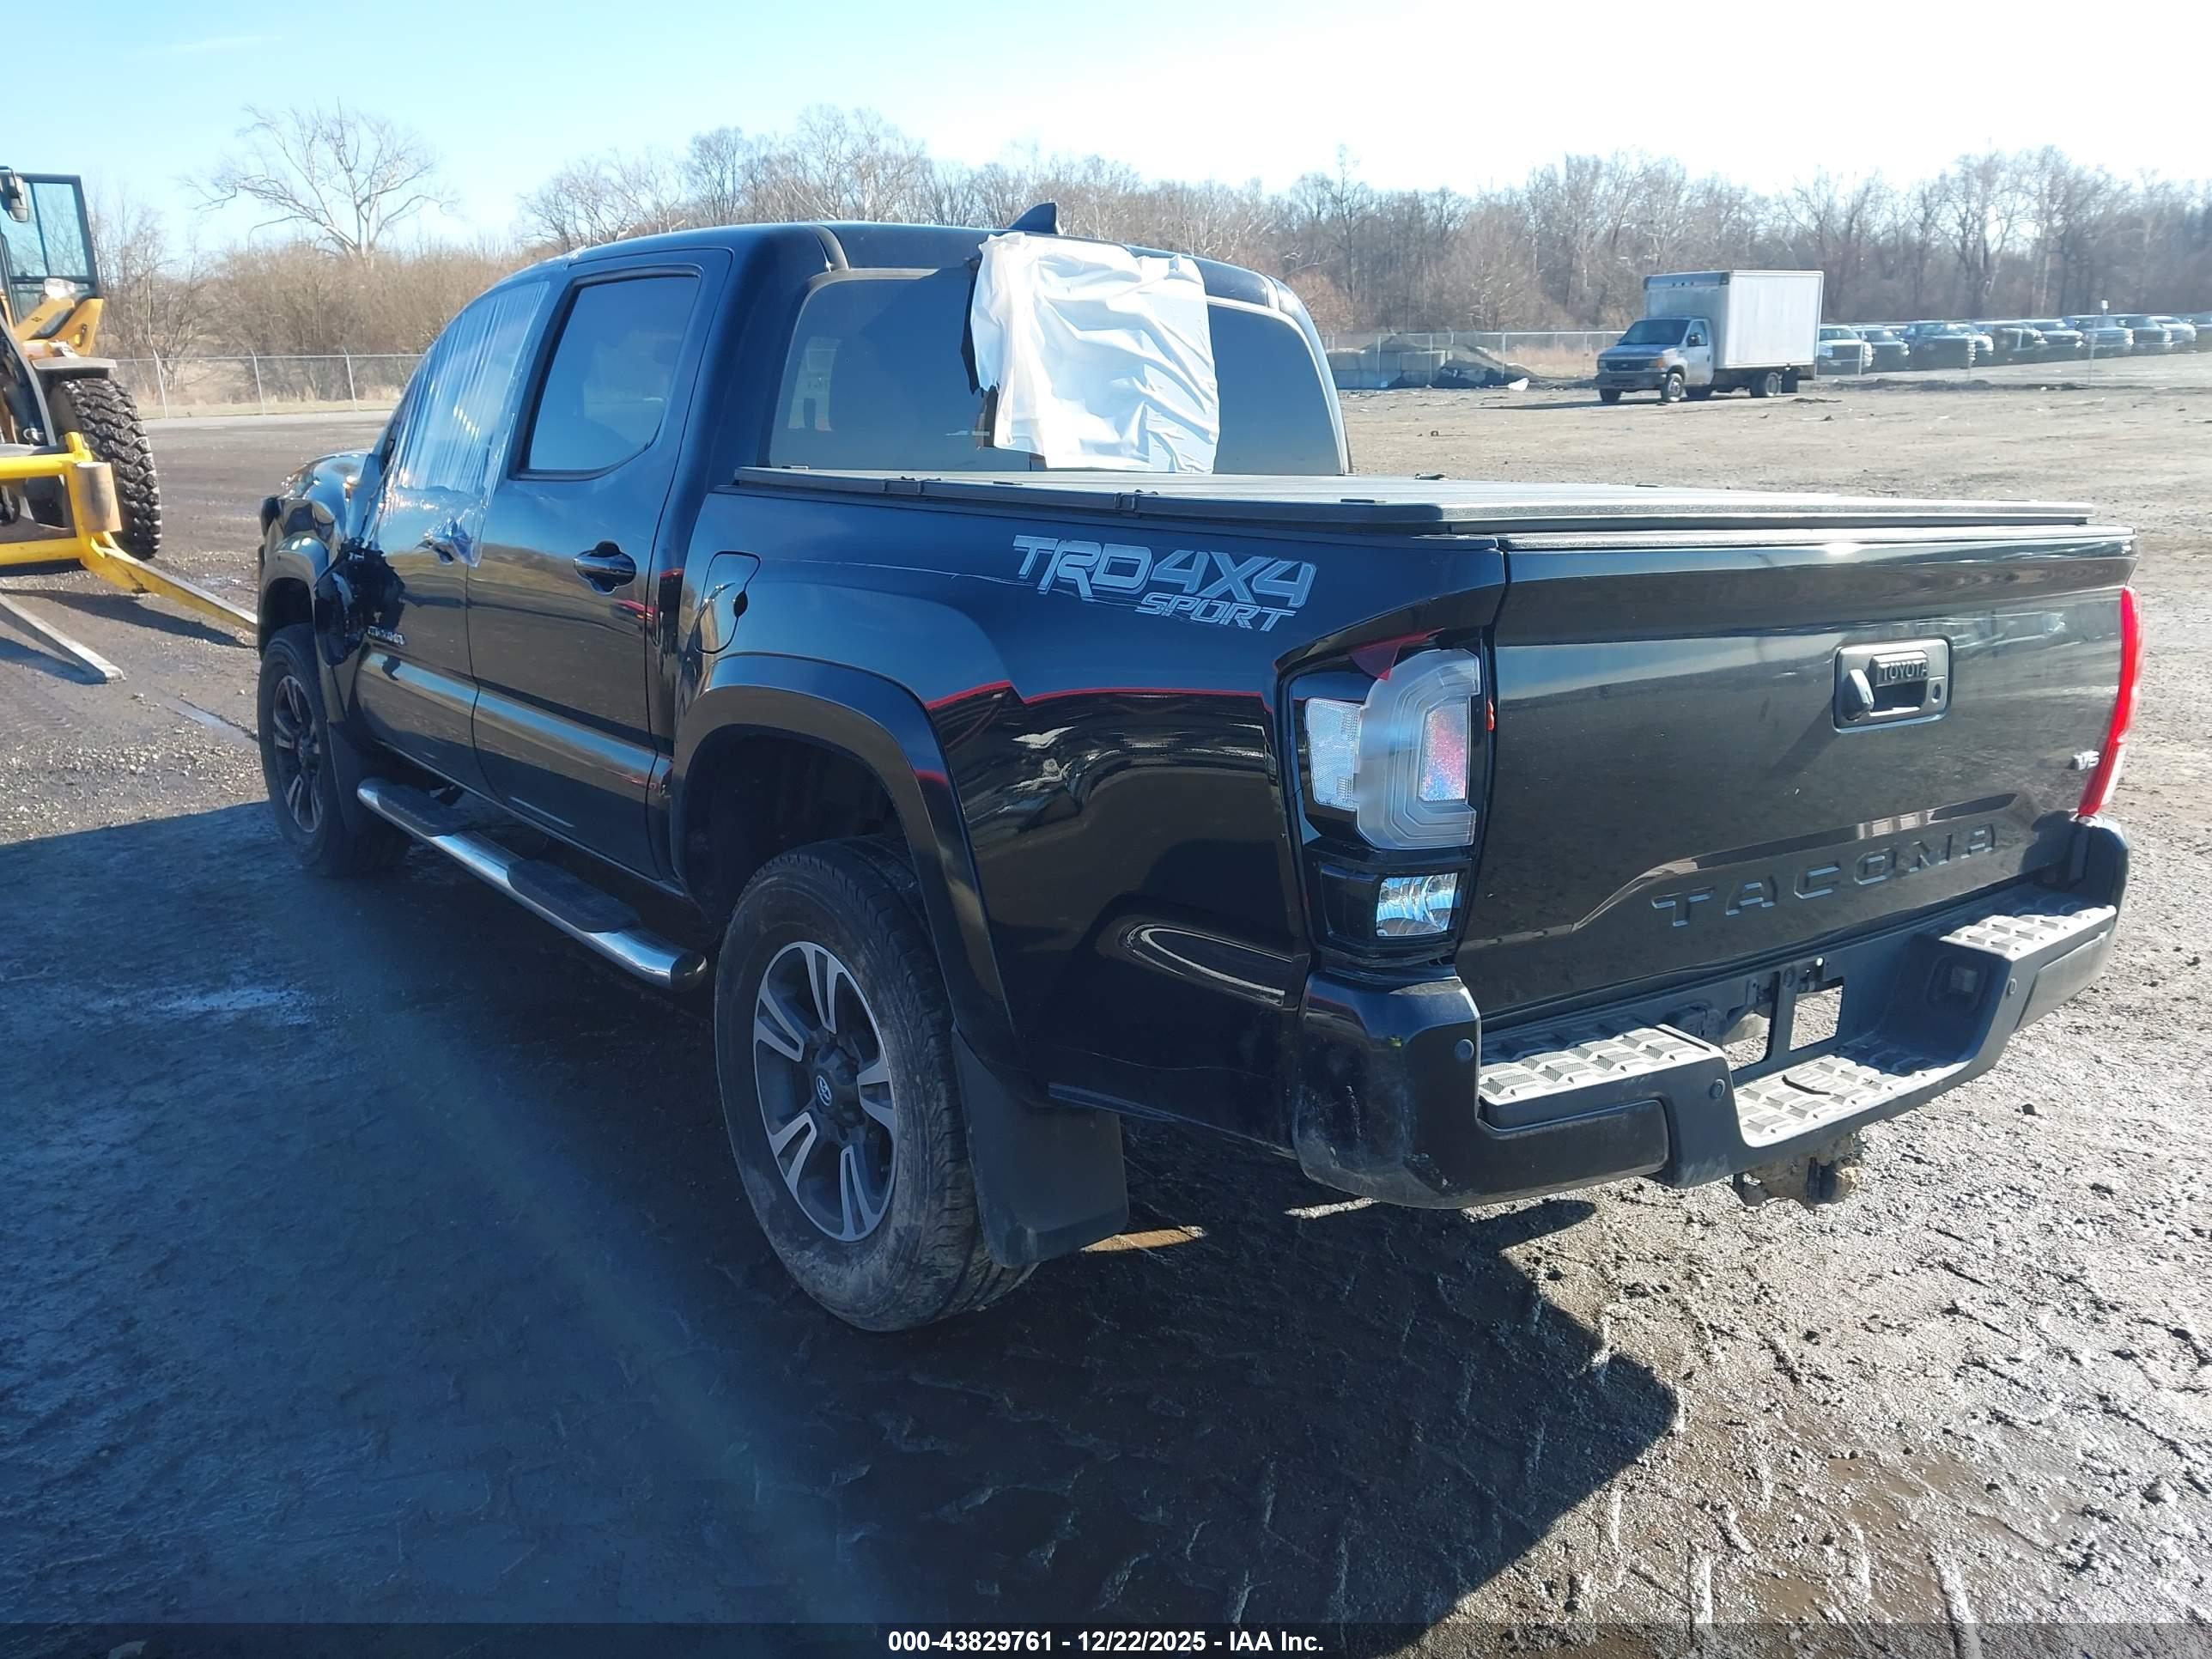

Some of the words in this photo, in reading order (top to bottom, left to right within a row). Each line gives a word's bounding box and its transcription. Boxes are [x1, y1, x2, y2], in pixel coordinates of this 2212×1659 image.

[1012, 534, 1153, 602] TRD
[1135, 592, 1297, 631] SPORT
[1881, 661, 1929, 681] TOYOTA
[2072, 750, 2100, 771] V6
[1651, 823, 1997, 927] TACOMA
